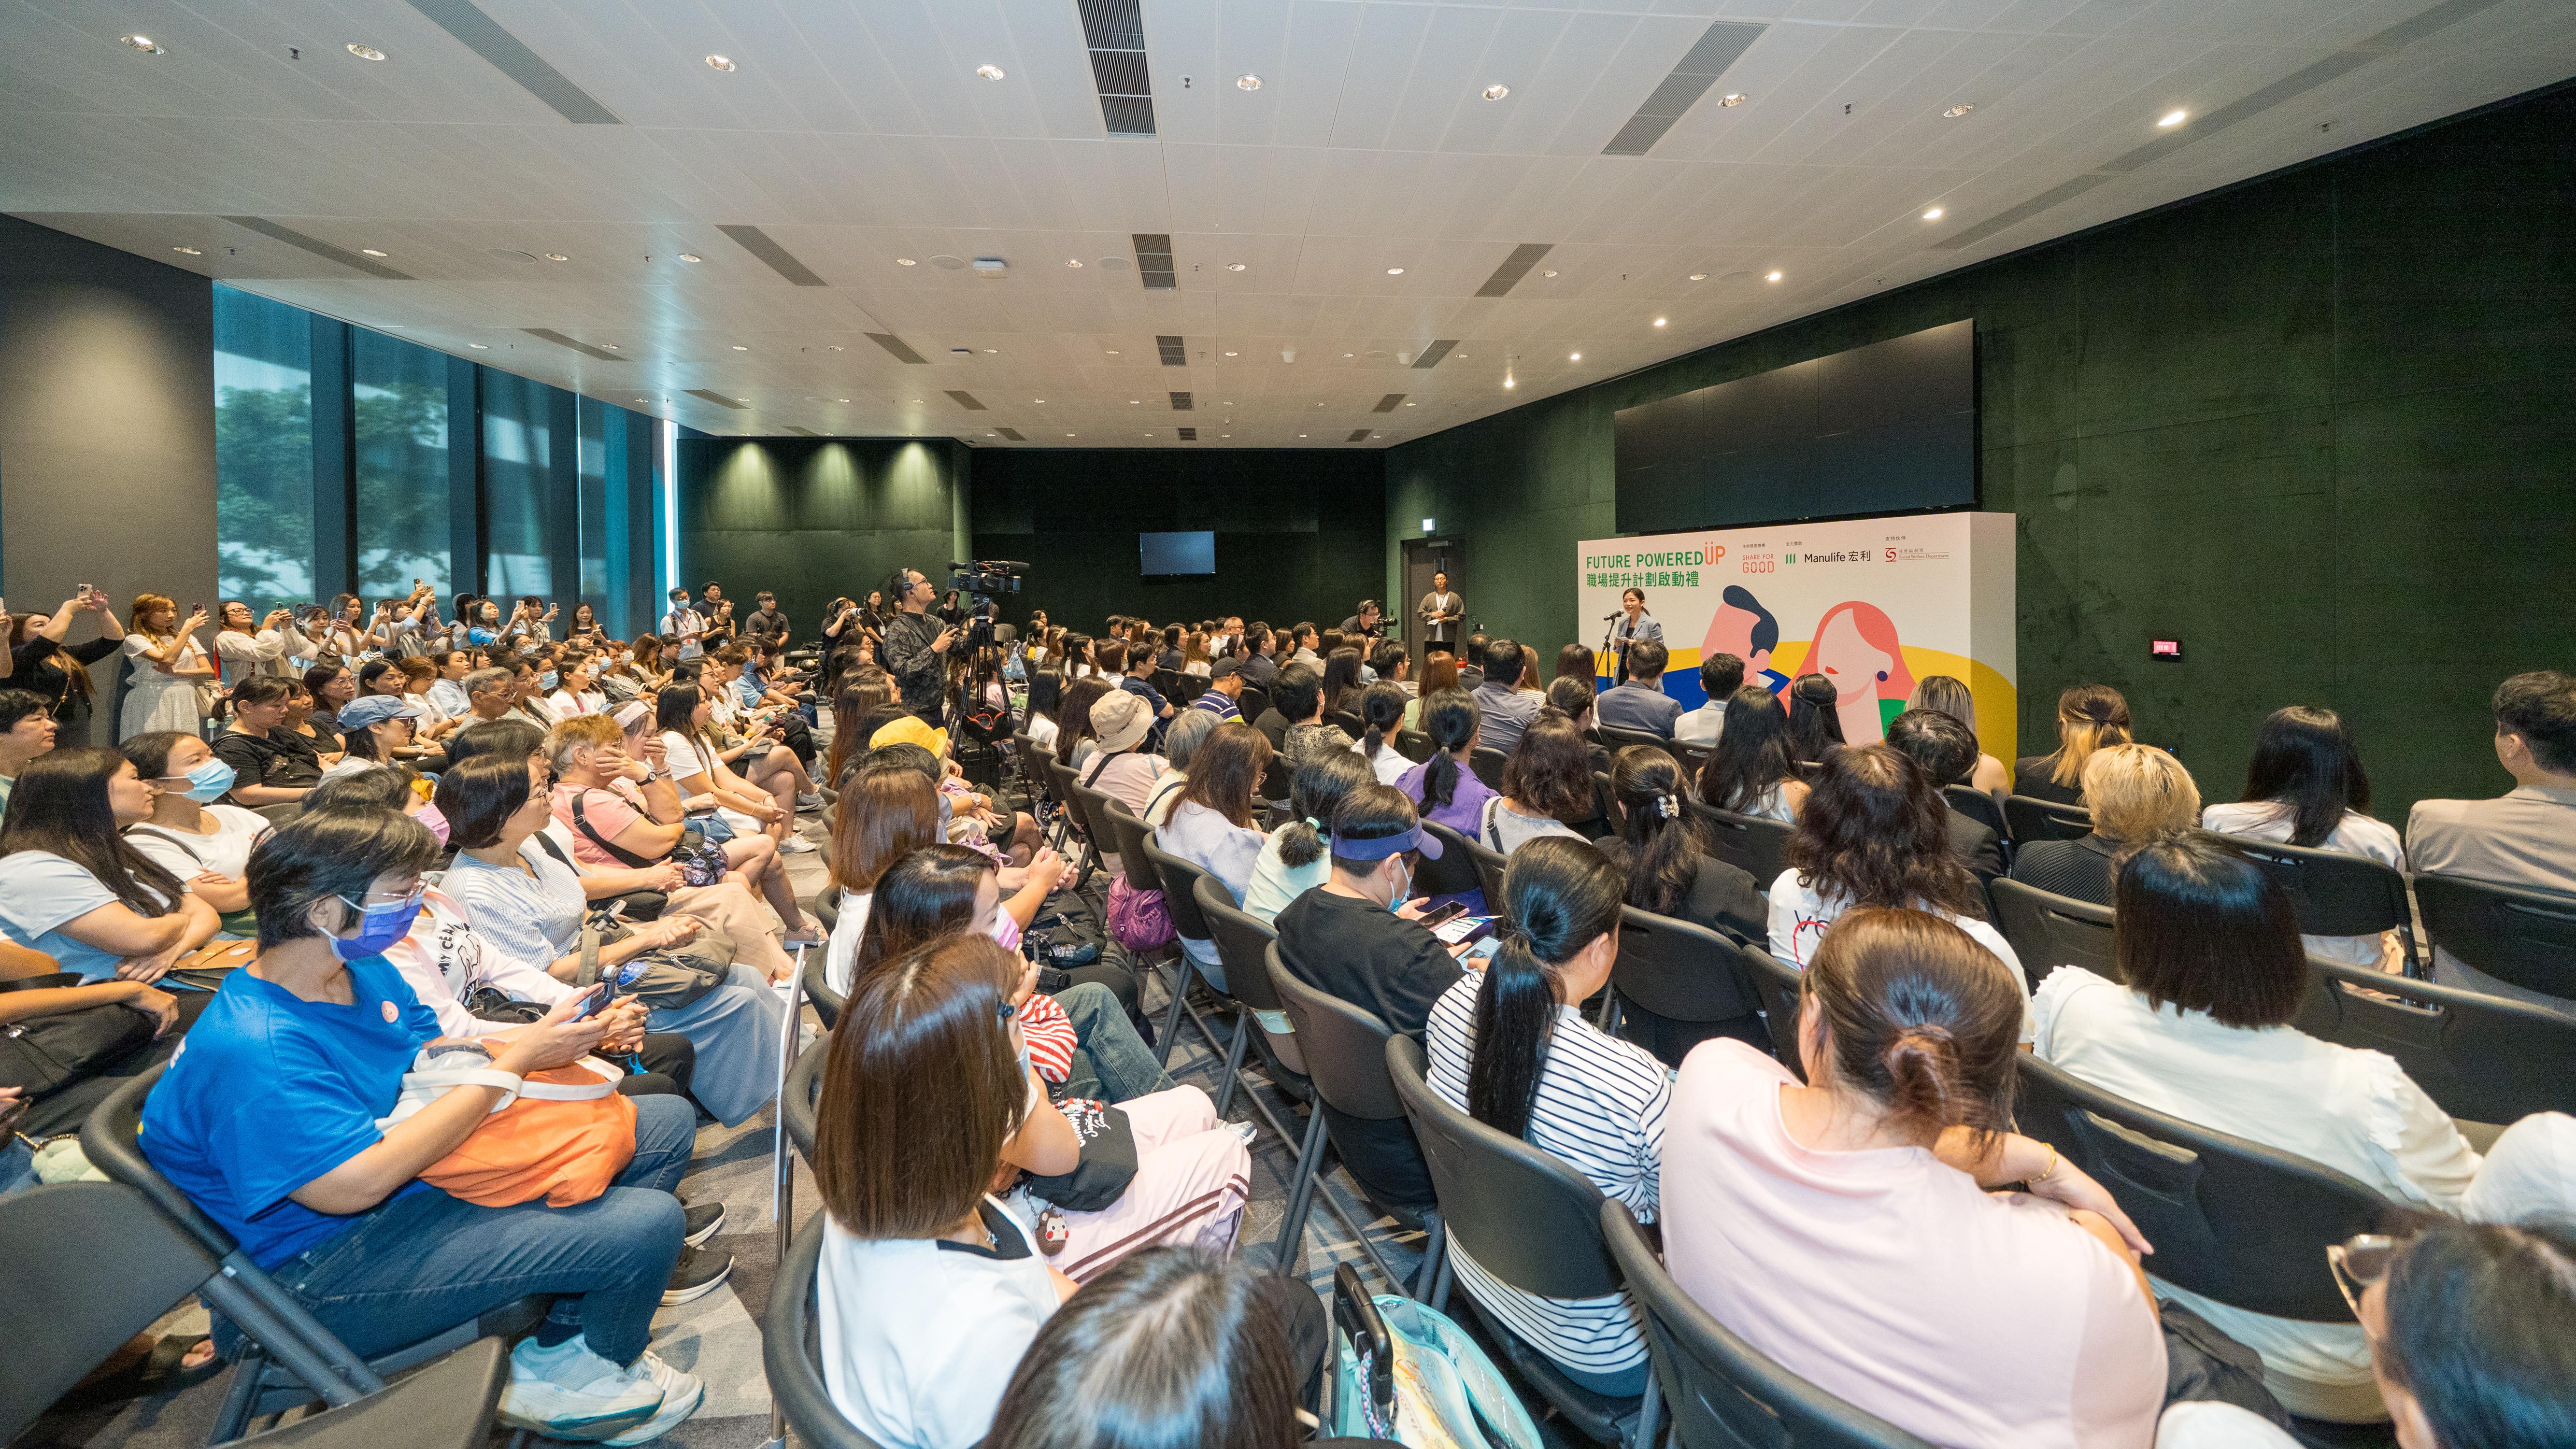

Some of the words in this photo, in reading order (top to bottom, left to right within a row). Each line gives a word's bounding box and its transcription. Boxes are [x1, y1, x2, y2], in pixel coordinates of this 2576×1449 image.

[1586, 554, 1631, 569] FUTURE
[1637, 551, 1704, 568] POWERED
[1805, 552, 1846, 563] Manulife
[1848, 550, 1871, 562] 宏利
[1742, 561, 1775, 574] GOOD
[1586, 570, 1699, 588] 職場提升計劃啟動禮
